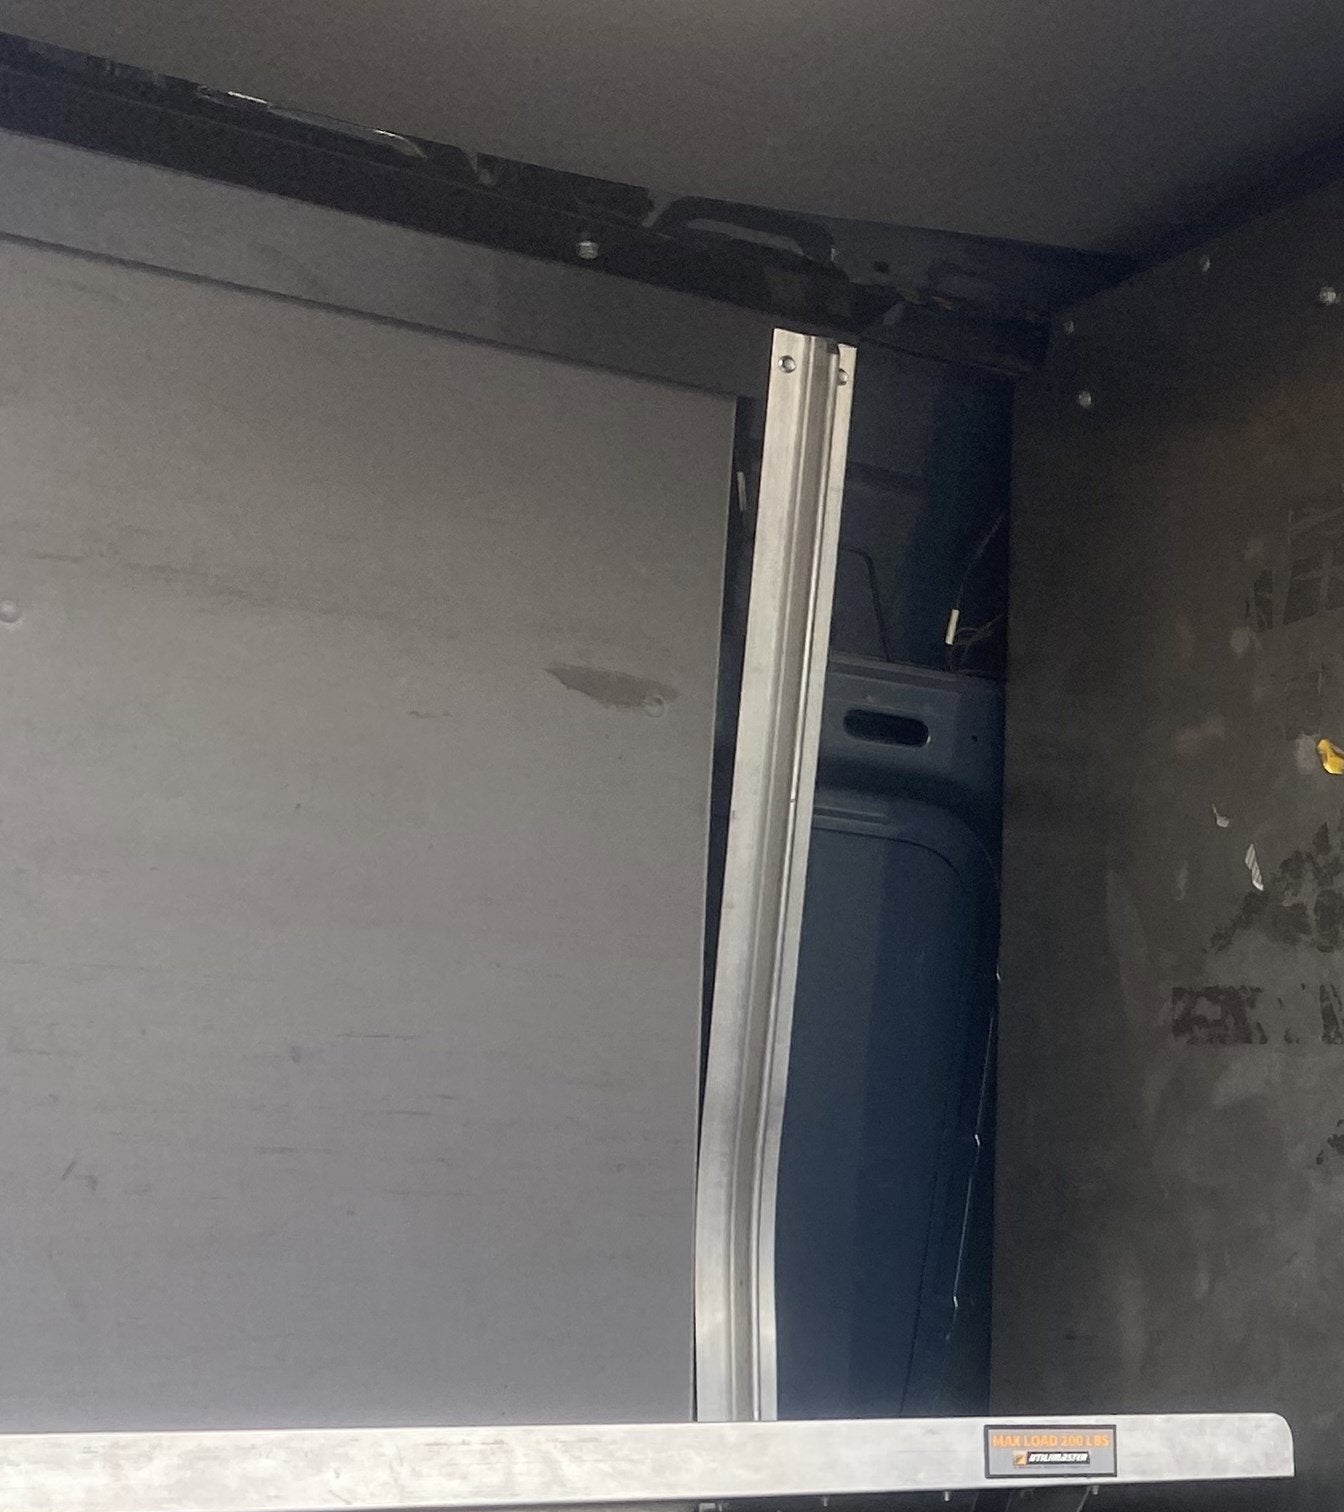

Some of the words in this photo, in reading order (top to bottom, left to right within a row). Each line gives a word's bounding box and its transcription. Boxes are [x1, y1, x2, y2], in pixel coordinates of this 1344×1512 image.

[992, 1434, 1020, 1447] MAX
[1024, 1434, 1057, 1447] LOAD
[1061, 1434, 1083, 1447] 200
[1086, 1434, 1109, 1447] LBS
